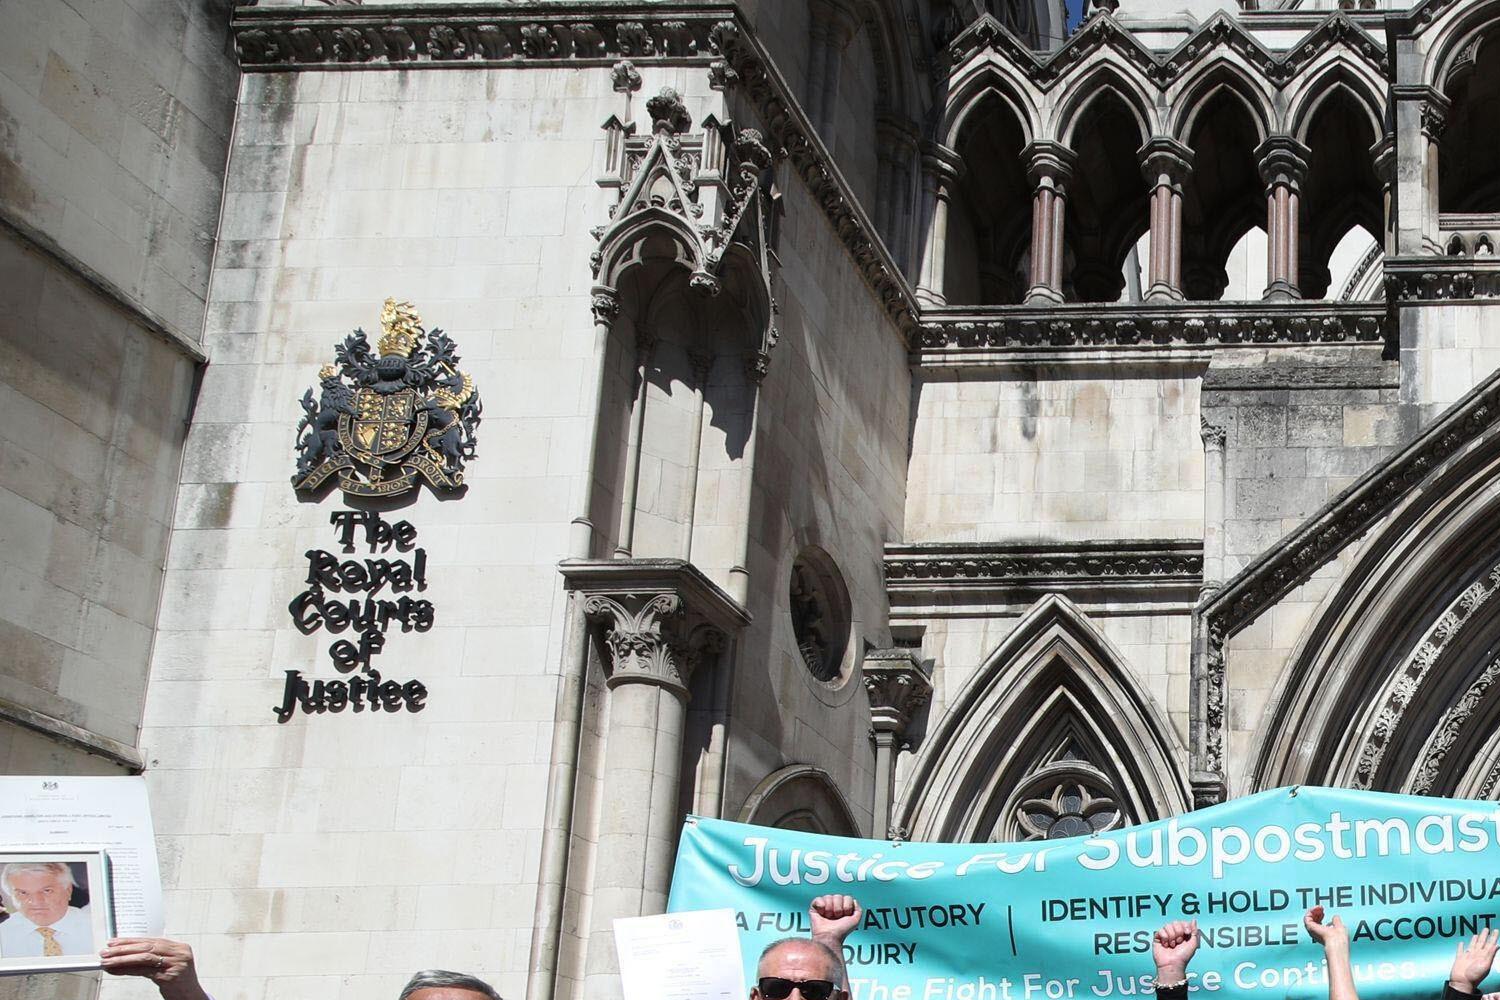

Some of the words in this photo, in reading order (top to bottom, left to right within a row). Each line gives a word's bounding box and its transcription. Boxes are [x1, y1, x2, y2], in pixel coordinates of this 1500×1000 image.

[330, 511, 417, 554] The
[305, 549, 428, 594] Royal
[288, 588, 435, 636] Courts
[329, 628, 385, 673] of
[273, 670, 428, 725] Justice
[728, 837, 945, 888] Justice
[955, 845, 1065, 877] For
[735, 911, 749, 931] A
[756, 911, 811, 932] FUL
[853, 902, 986, 931] ATUTORY
[1041, 893, 1174, 922] IDENTIFY
[1181, 892, 1200, 915] &
[1207, 889, 1290, 914] HOLD
[1296, 885, 1353, 910] THE
[1094, 923, 1299, 956] RESNSIBLE
[1353, 913, 1497, 943] ACCOUNT
[1023, 972, 1080, 1000] For
[1090, 968, 1222, 998] Jusce
[1234, 957, 1417, 990] Contiues
